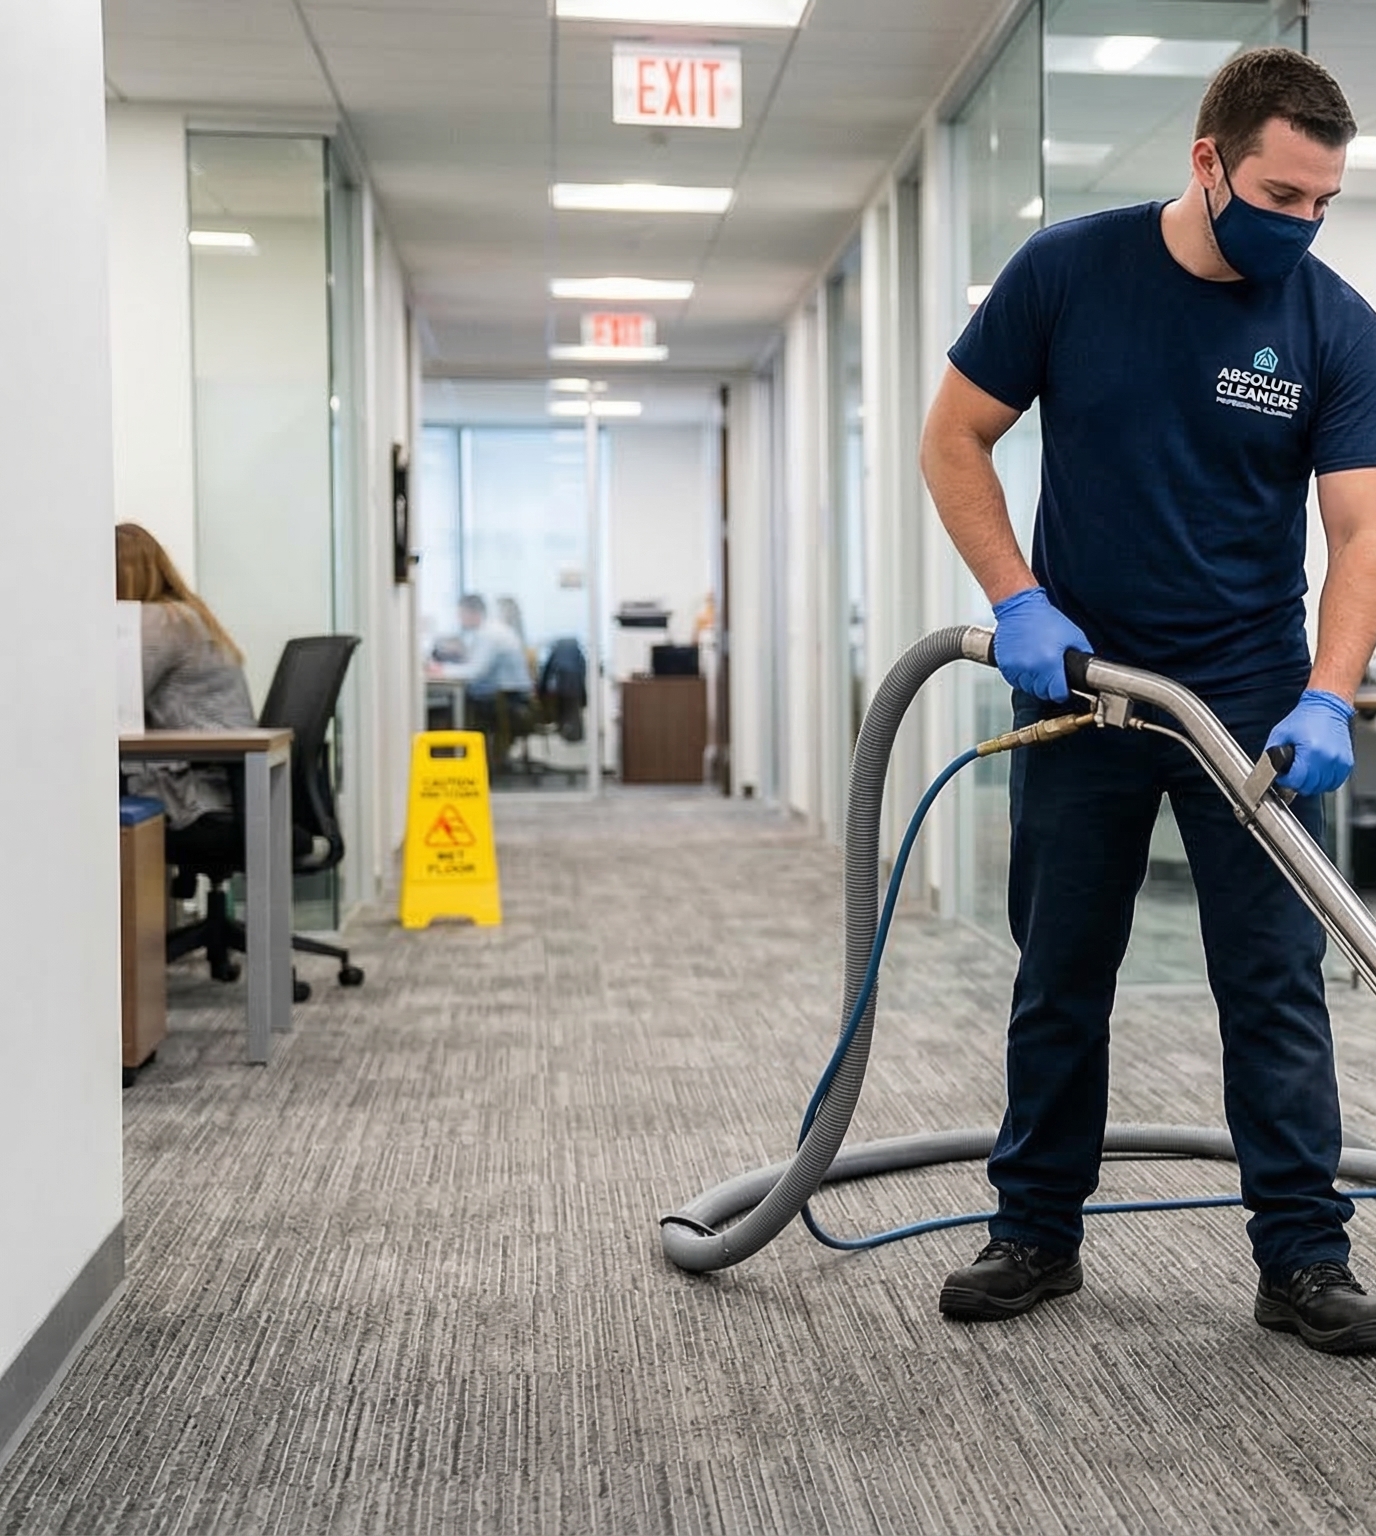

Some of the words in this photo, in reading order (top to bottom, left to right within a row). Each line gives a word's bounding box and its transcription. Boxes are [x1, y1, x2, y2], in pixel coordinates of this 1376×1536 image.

[637, 58, 721, 118] EXIT
[1216, 381, 1299, 411] CLEANERS
[1217, 367, 1302, 398] ABSOLUTE
